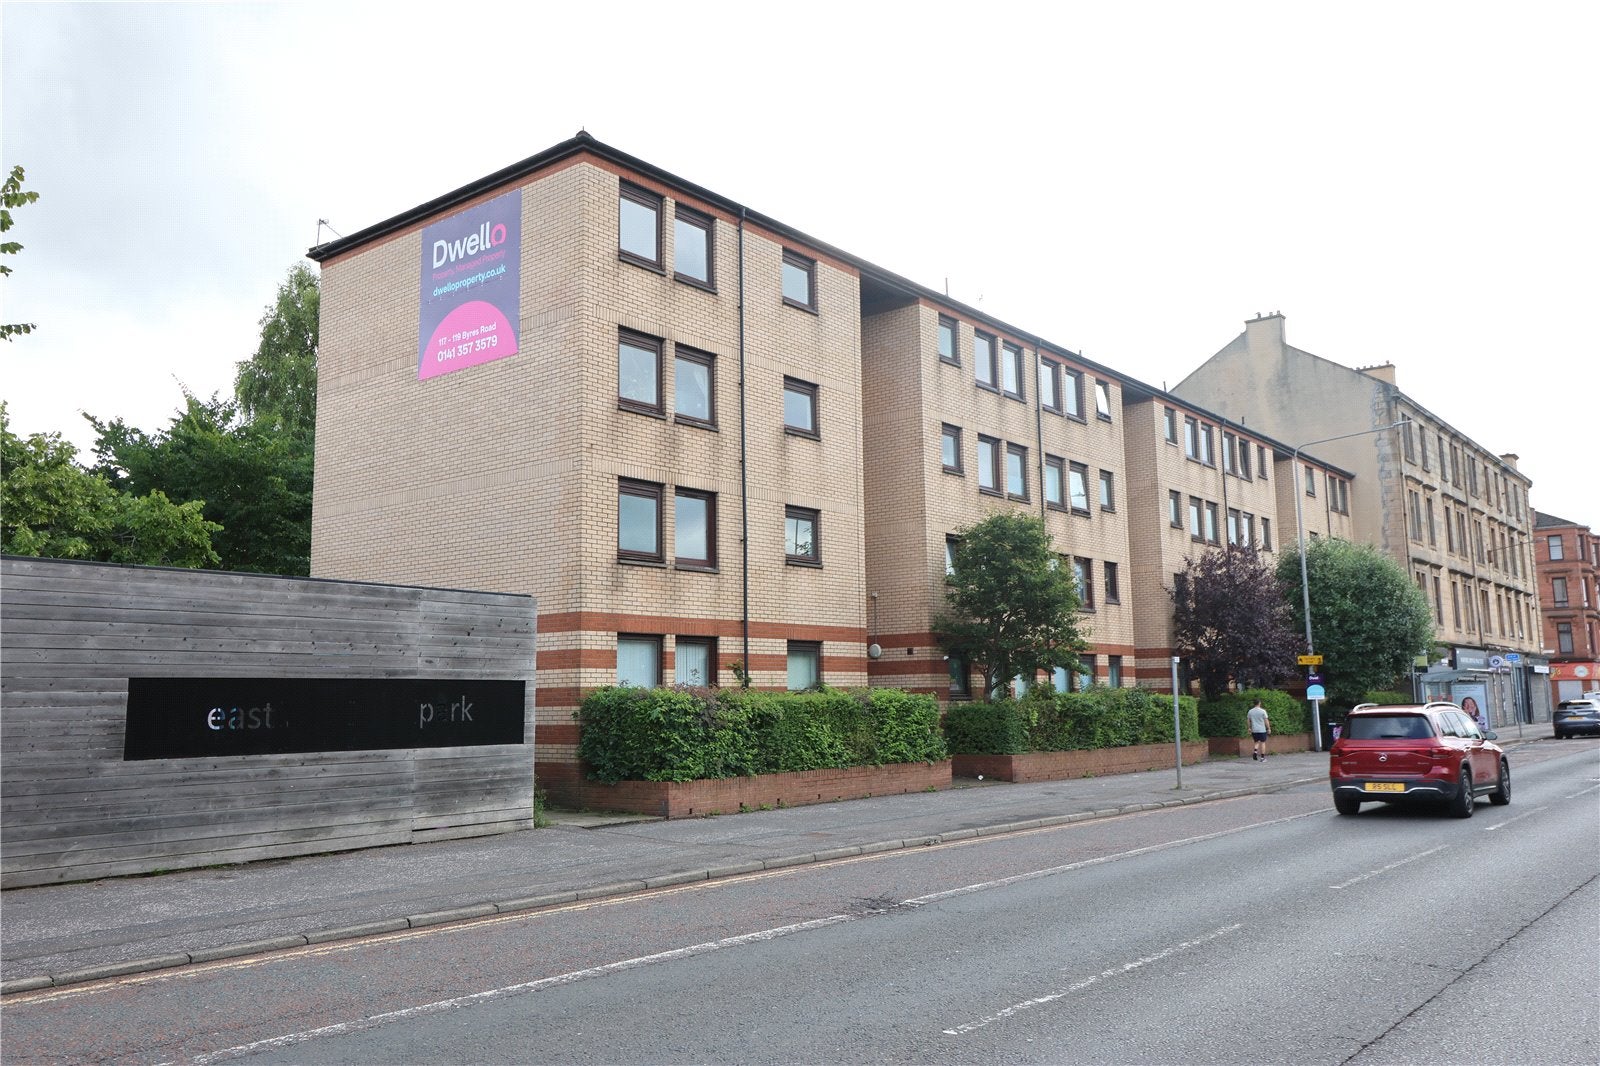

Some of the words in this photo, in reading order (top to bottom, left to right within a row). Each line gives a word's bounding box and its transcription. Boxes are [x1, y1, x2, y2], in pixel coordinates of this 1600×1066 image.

[432, 221, 507, 269] Dwello
[432, 264, 506, 297] dwelloproperty.co.uk
[462, 329, 479, 340] Byres
[480, 322, 497, 334] Road
[437, 347, 456, 362] 0141
[457, 342, 474, 357] 357
[475, 335, 498, 351] 3579
[207, 702, 274, 730] east
[419, 695, 473, 729] prk
